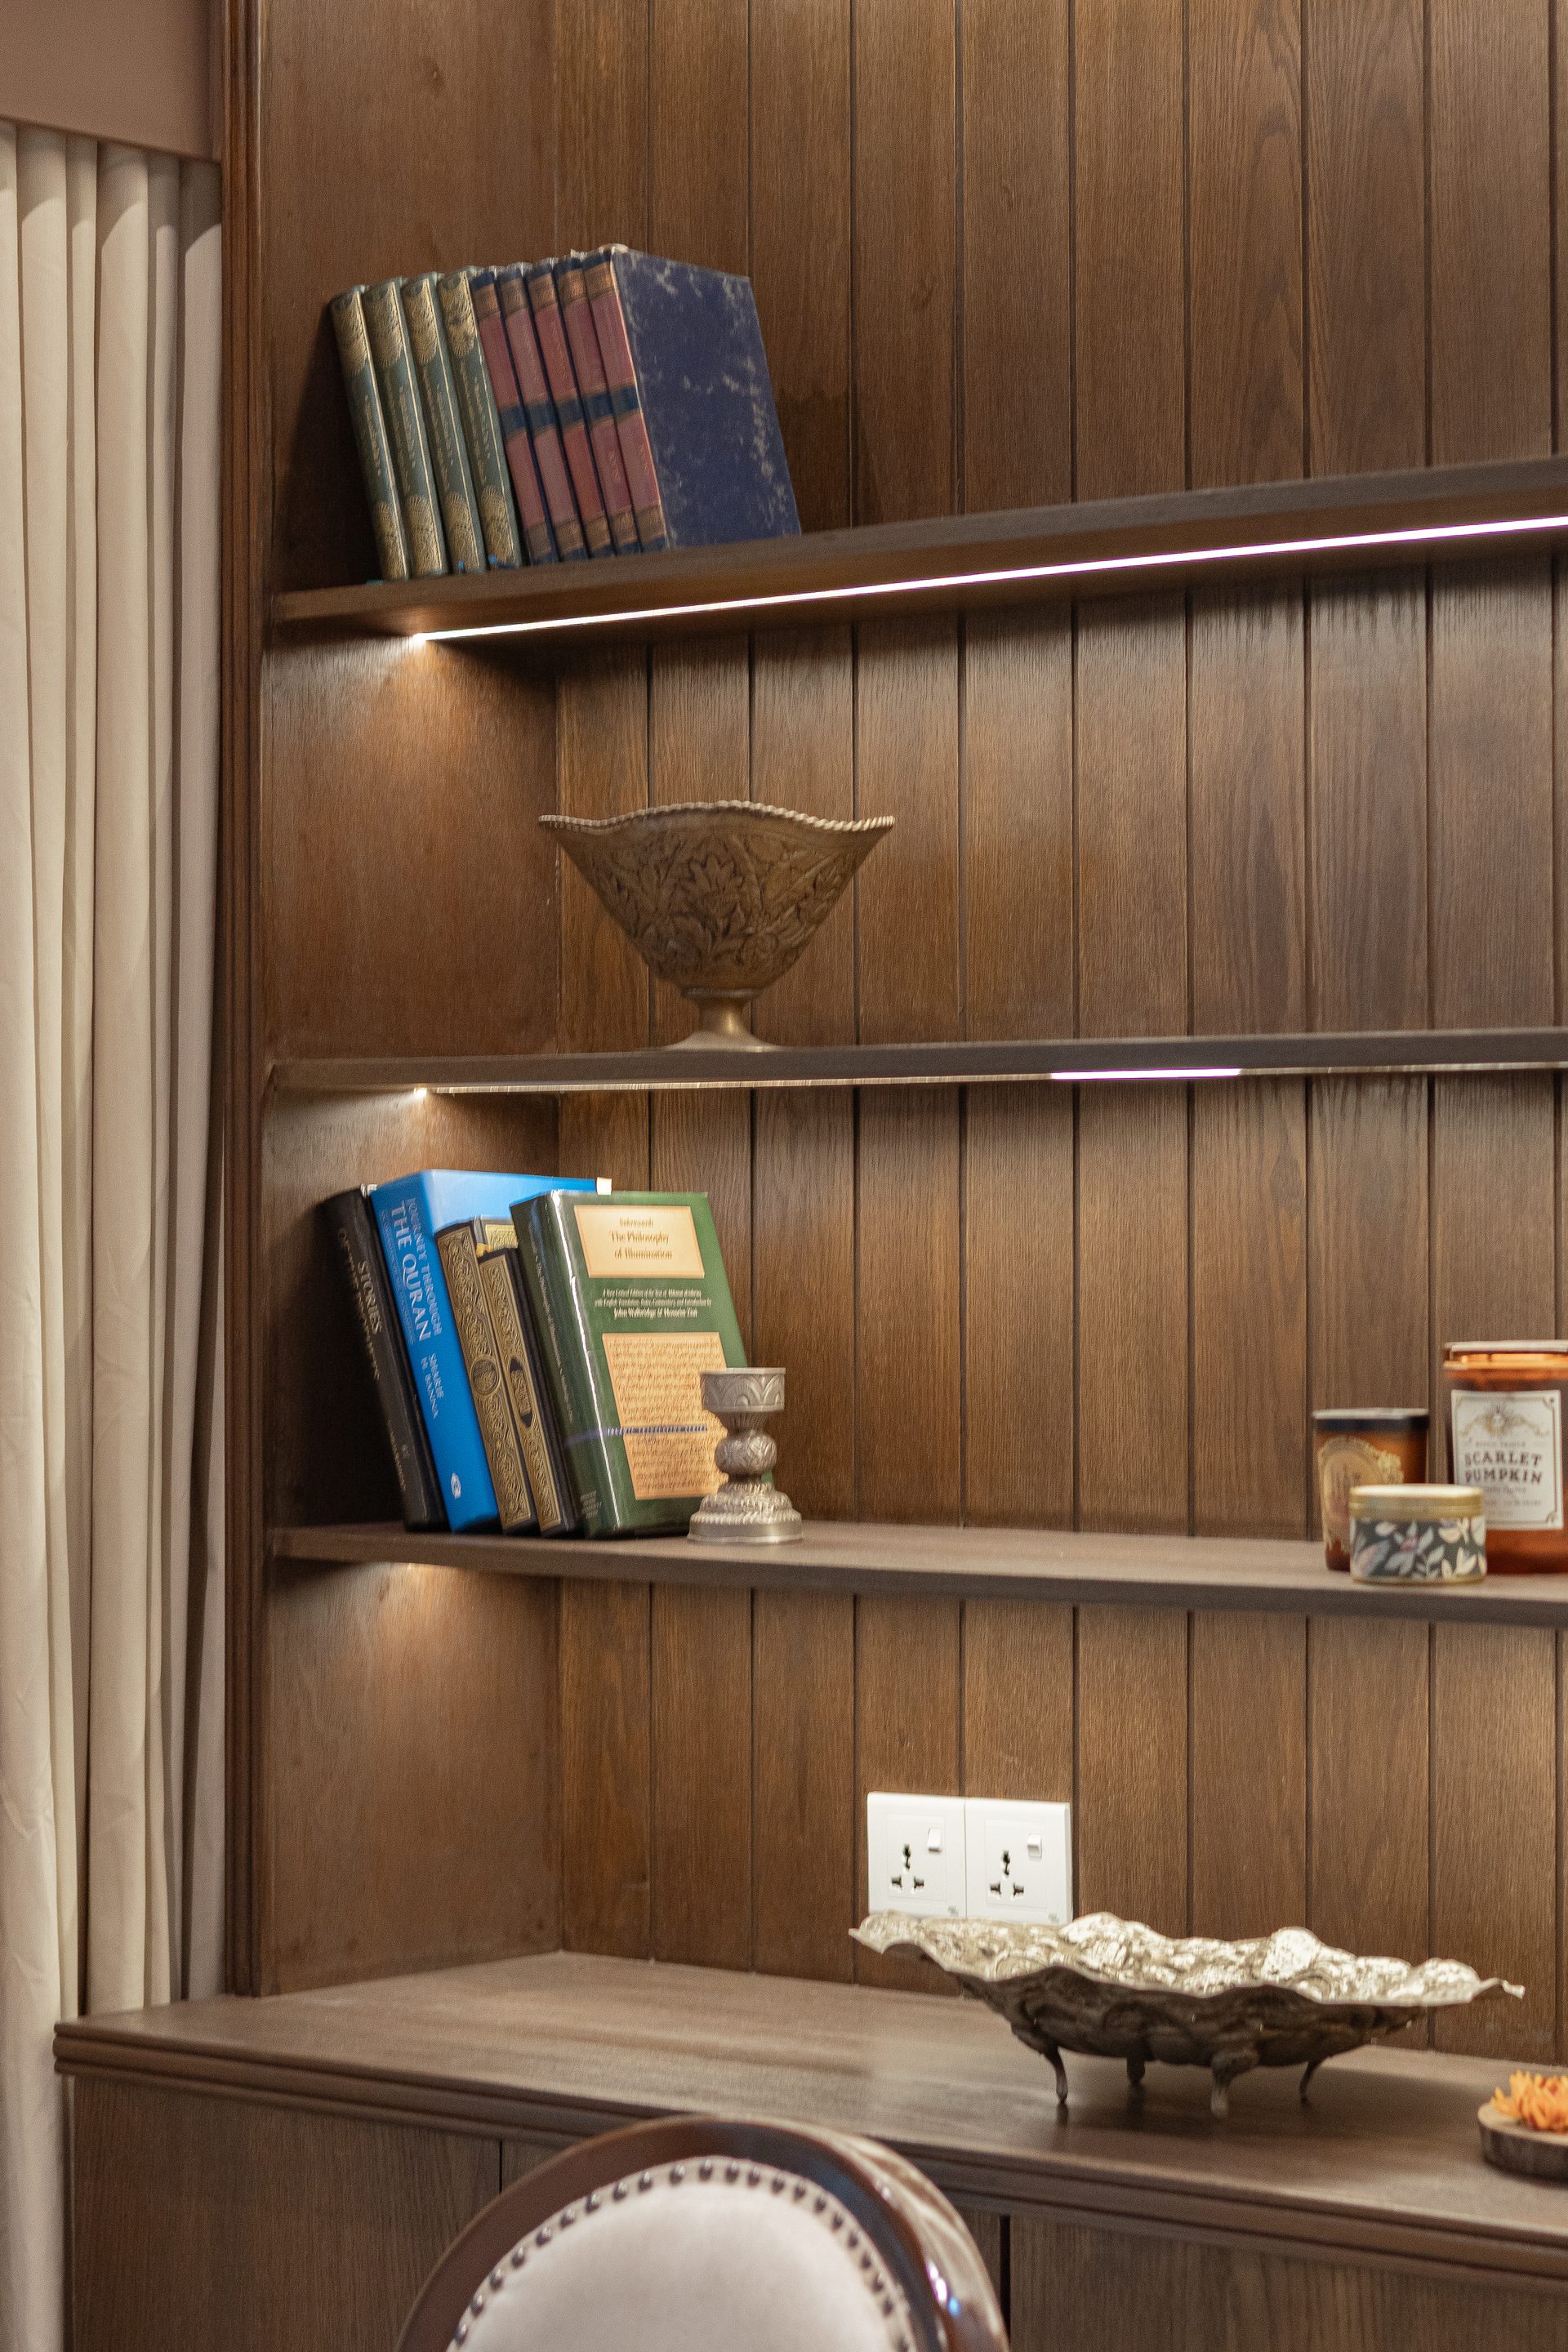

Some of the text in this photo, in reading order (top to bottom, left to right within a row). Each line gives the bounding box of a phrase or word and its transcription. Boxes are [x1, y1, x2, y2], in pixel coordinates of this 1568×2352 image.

[626, 1231, 670, 1246] Philosophy
[613, 1247, 673, 1260] of Illumination
[391, 1200, 412, 1250] THE
[402, 1253, 431, 1342] QURAN
[406, 1197, 443, 1335] JOURNEY THROUGH
[357, 1260, 383, 1335] STORIES
[1463, 1450, 1543, 1468] SCARLET
[1464, 1468, 1544, 1486] PUMPKIN
